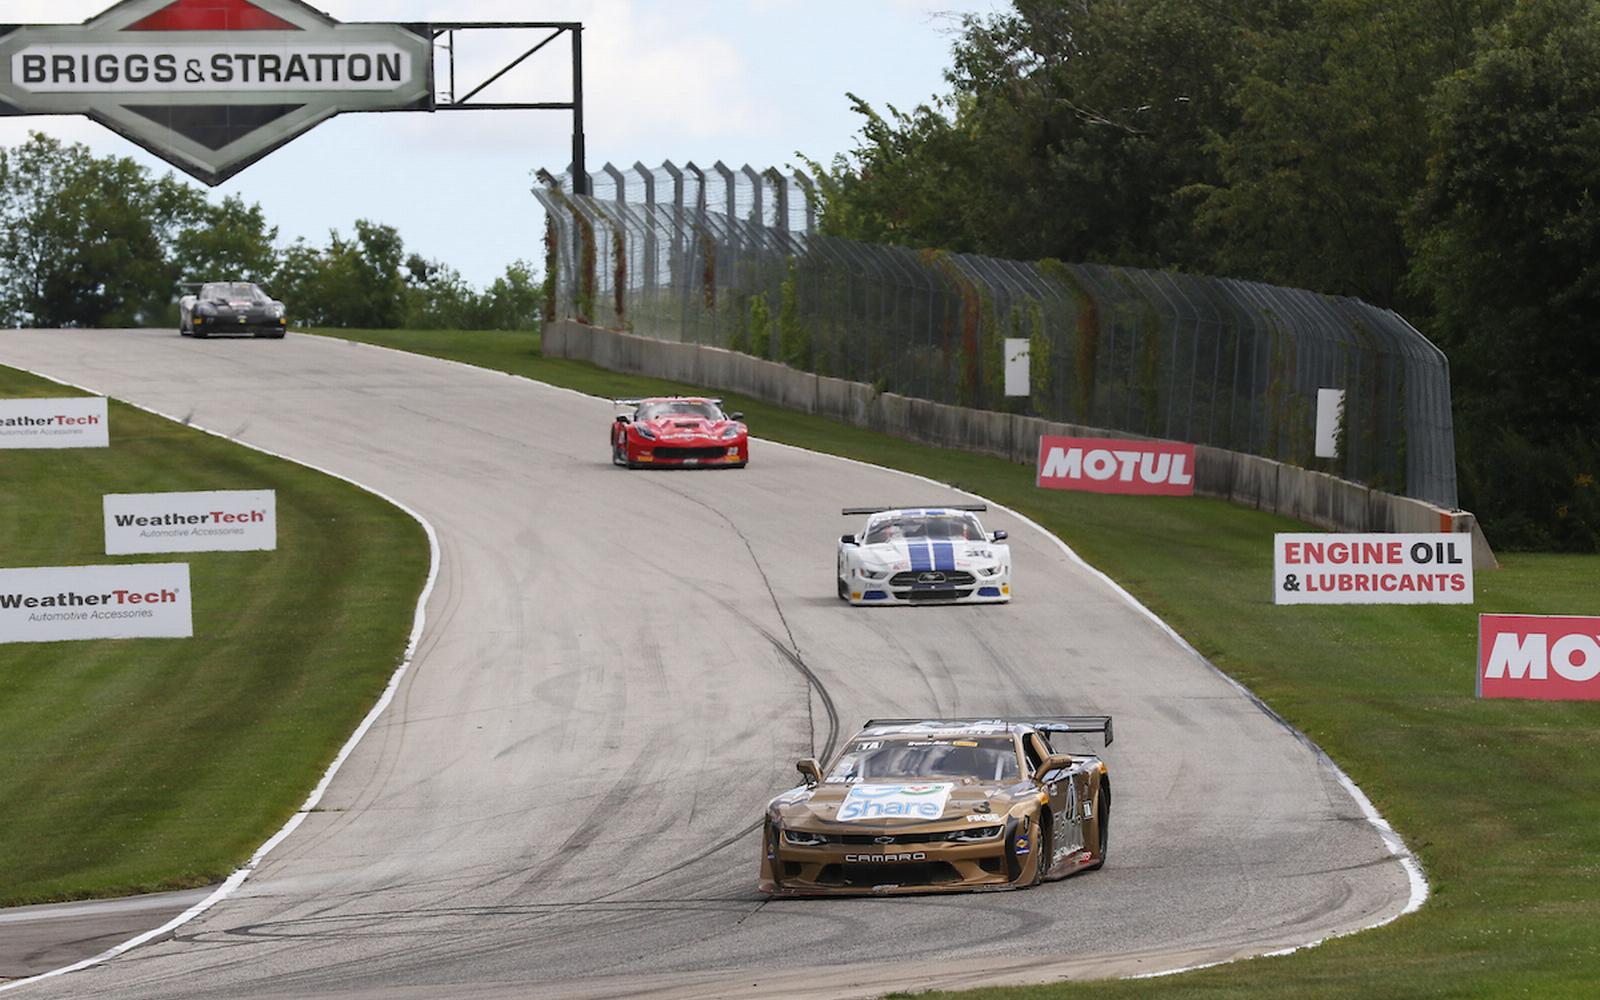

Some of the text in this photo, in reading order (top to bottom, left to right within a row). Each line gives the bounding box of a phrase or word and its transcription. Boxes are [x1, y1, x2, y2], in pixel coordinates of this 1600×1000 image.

[22, 53, 401, 83] BRIGGS & STRATTON
[1041, 447, 1192, 485] MOTUL
[115, 510, 264, 527] WeatherTech
[140, 527, 245, 538] Automotive Accessories
[1284, 542, 1463, 564] ENGINE OIL
[1283, 574, 1466, 592] & LUBRICANTS
[1, 588, 177, 609] WeatherTech
[28, 608, 153, 622] Automotive Accessories
[1484, 632, 1600, 682] MO
[844, 800, 940, 819] share
[846, 852, 927, 862] CAMARO
